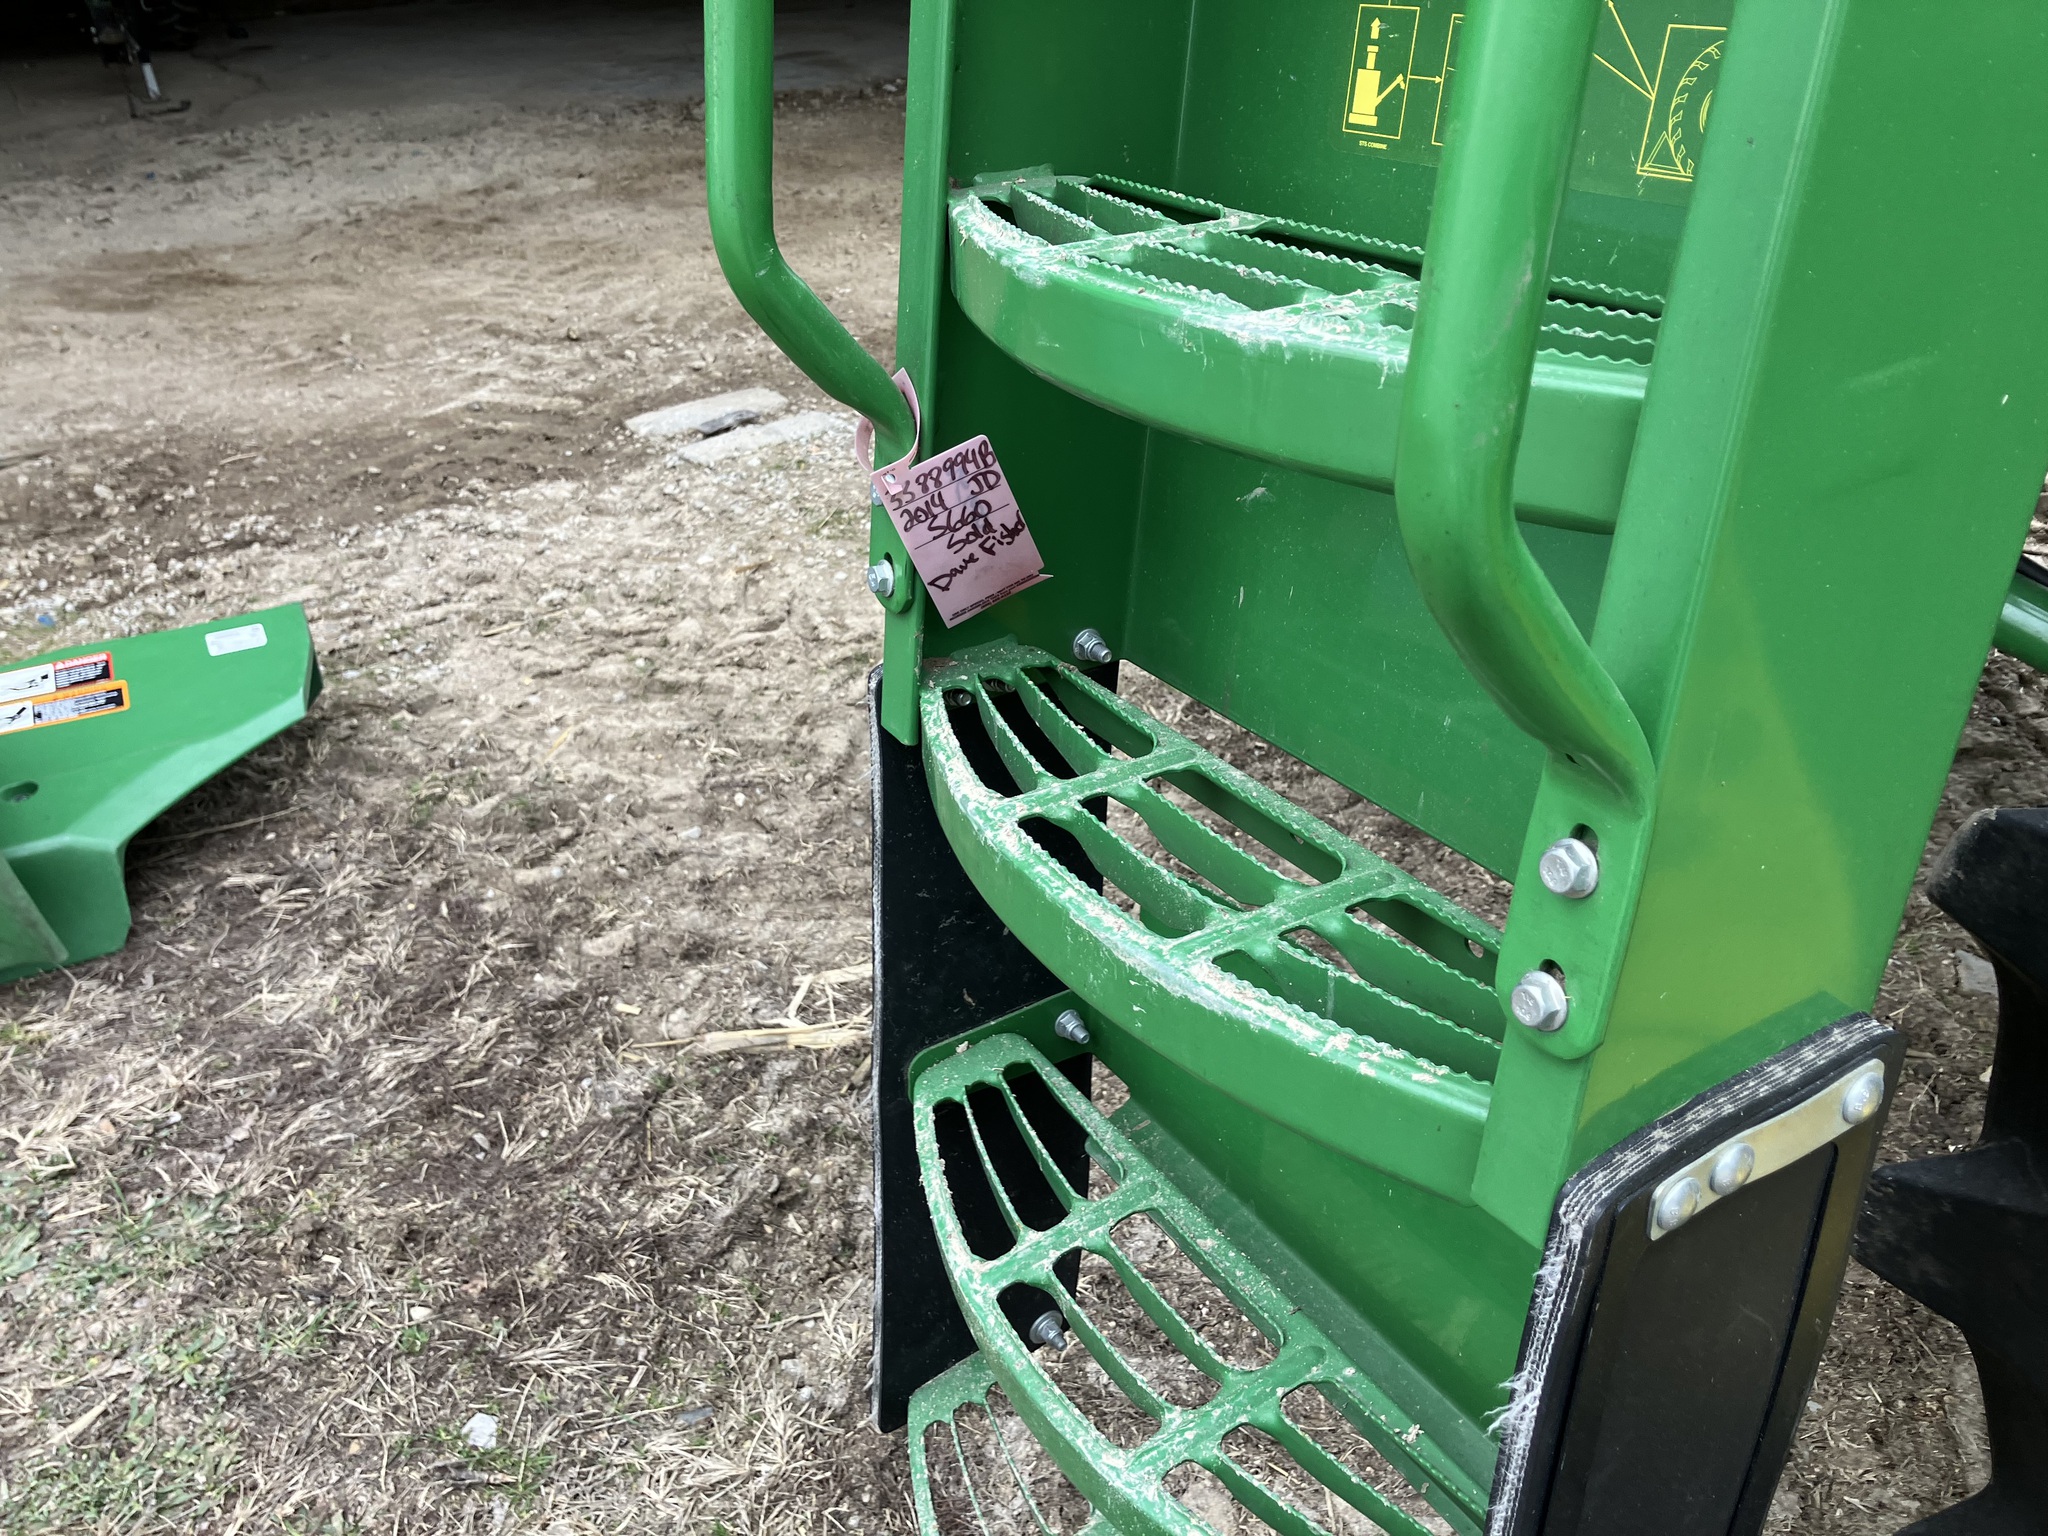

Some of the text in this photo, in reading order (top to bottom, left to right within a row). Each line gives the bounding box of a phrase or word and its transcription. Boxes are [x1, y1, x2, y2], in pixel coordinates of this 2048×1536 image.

[900, 470, 1002, 532] 2014 JD
[927, 499, 993, 541] S660
[947, 519, 997, 554] Sold
[927, 553, 979, 592] Dave
